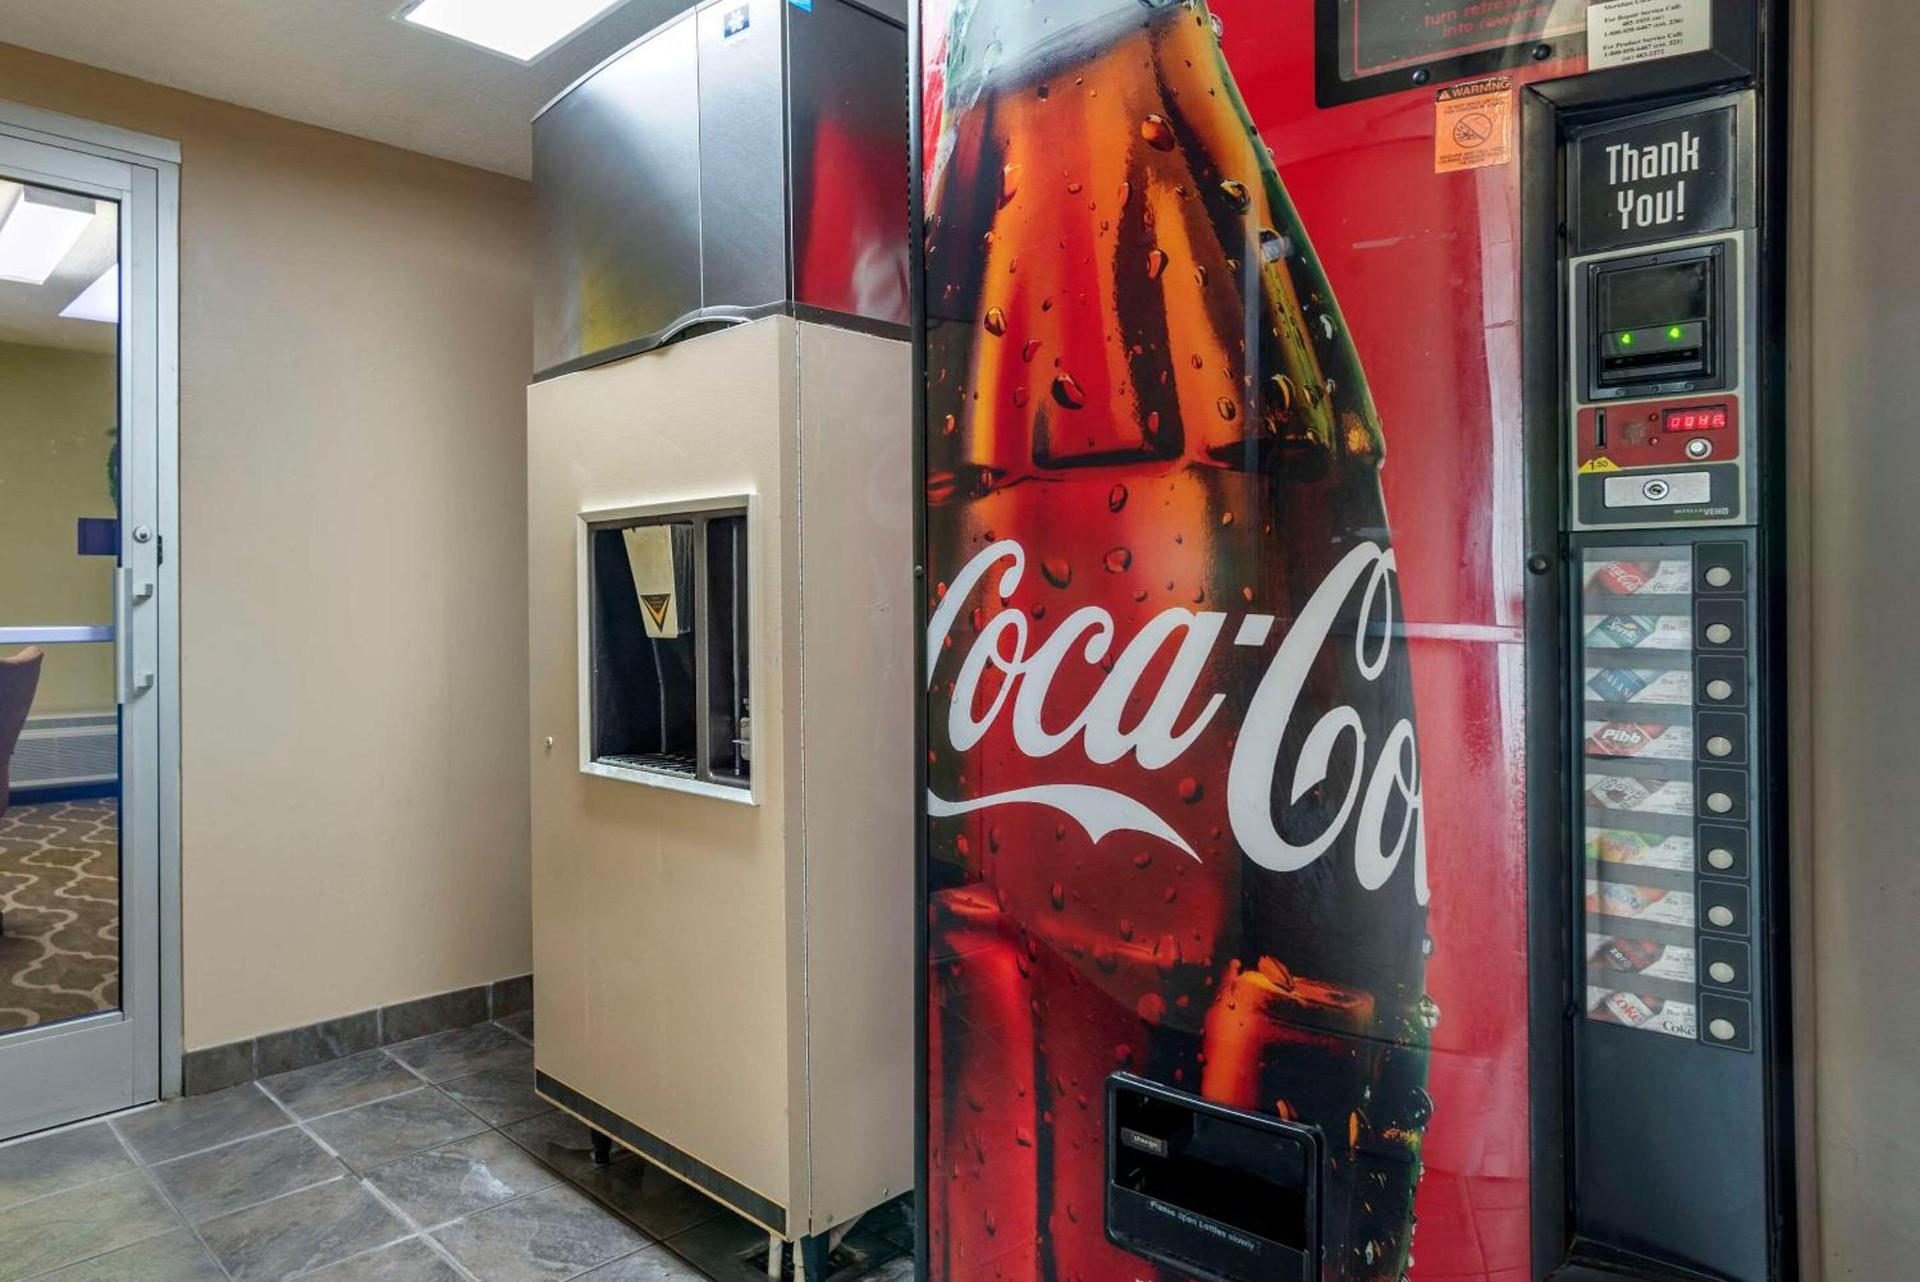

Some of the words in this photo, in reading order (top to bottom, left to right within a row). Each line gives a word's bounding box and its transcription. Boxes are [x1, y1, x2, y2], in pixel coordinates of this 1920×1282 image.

[1442, 22, 1474, 38] into
[1451, 81, 1513, 97] WARNING
[1605, 130, 1700, 185] Thank
[1617, 180, 1685, 230] You!
[1602, 728, 1641, 744] Pibb
